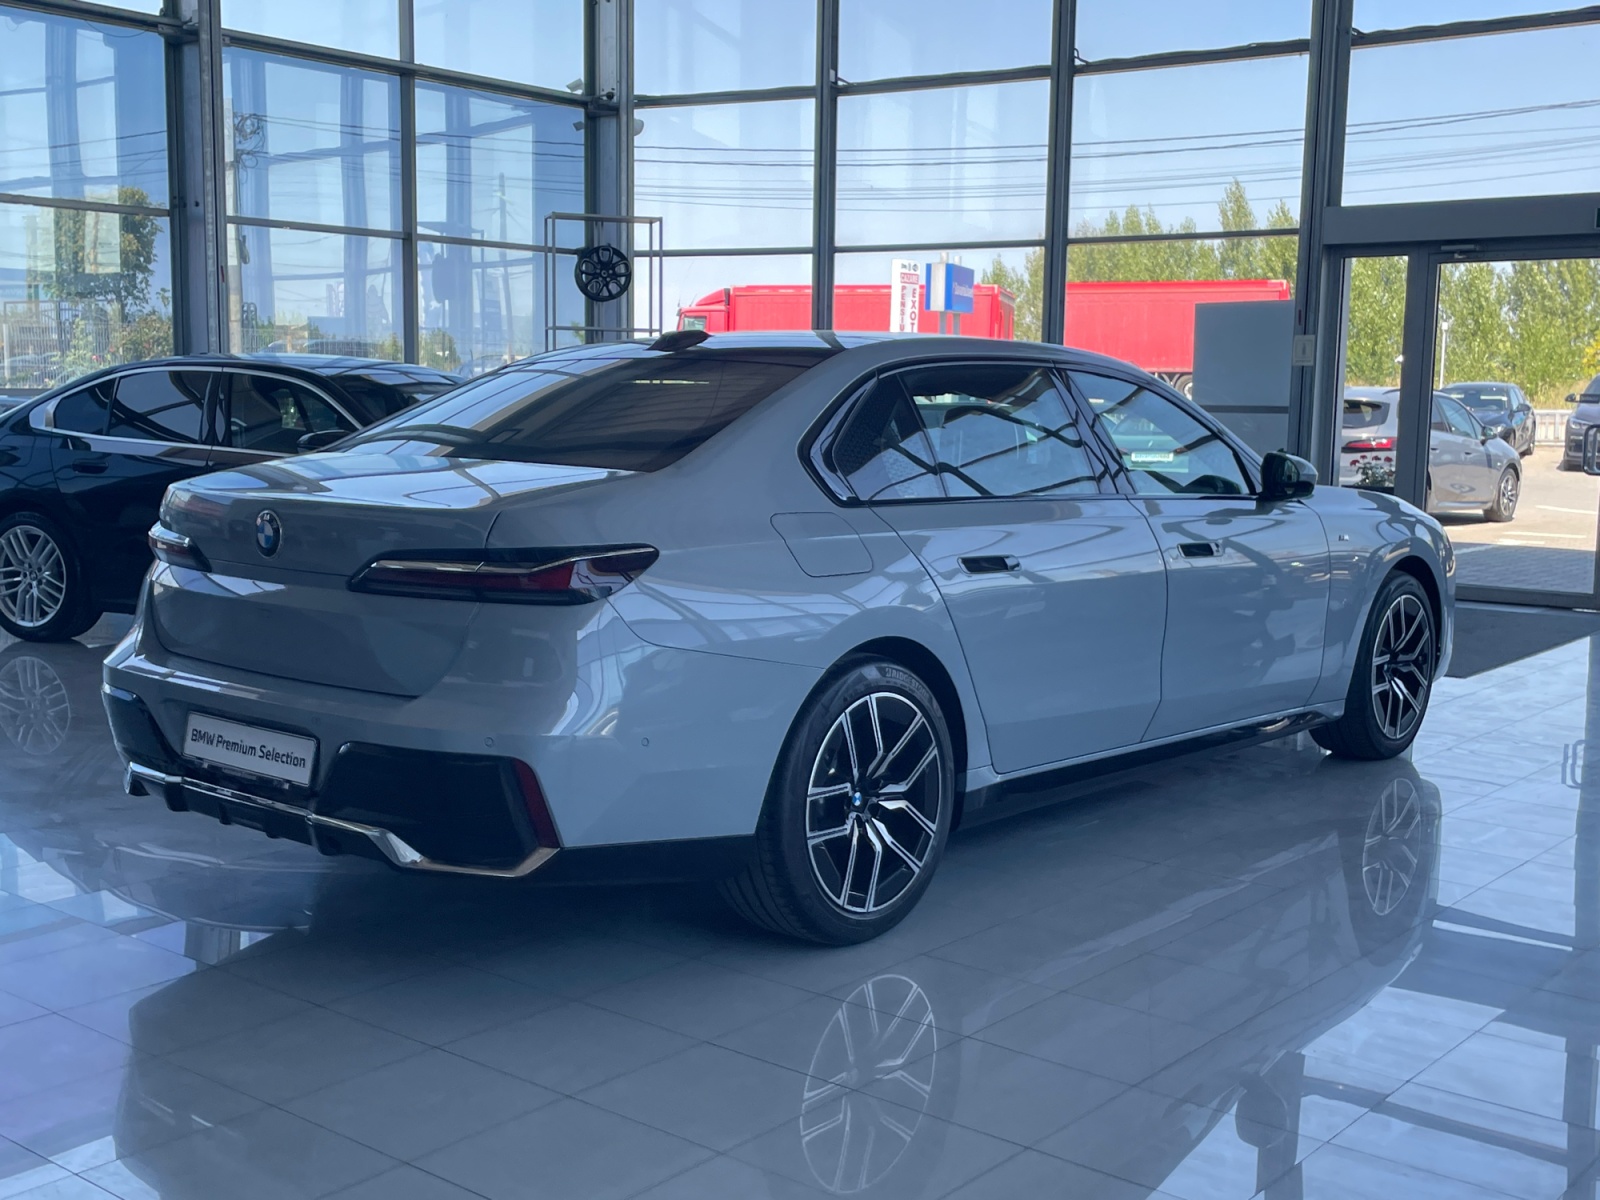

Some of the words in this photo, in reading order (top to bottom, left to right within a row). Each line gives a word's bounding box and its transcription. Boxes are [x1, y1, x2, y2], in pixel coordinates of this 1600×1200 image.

[190, 728, 215, 746] BMW
[216, 734, 257, 756] Premium
[258, 744, 306, 768] Selection
